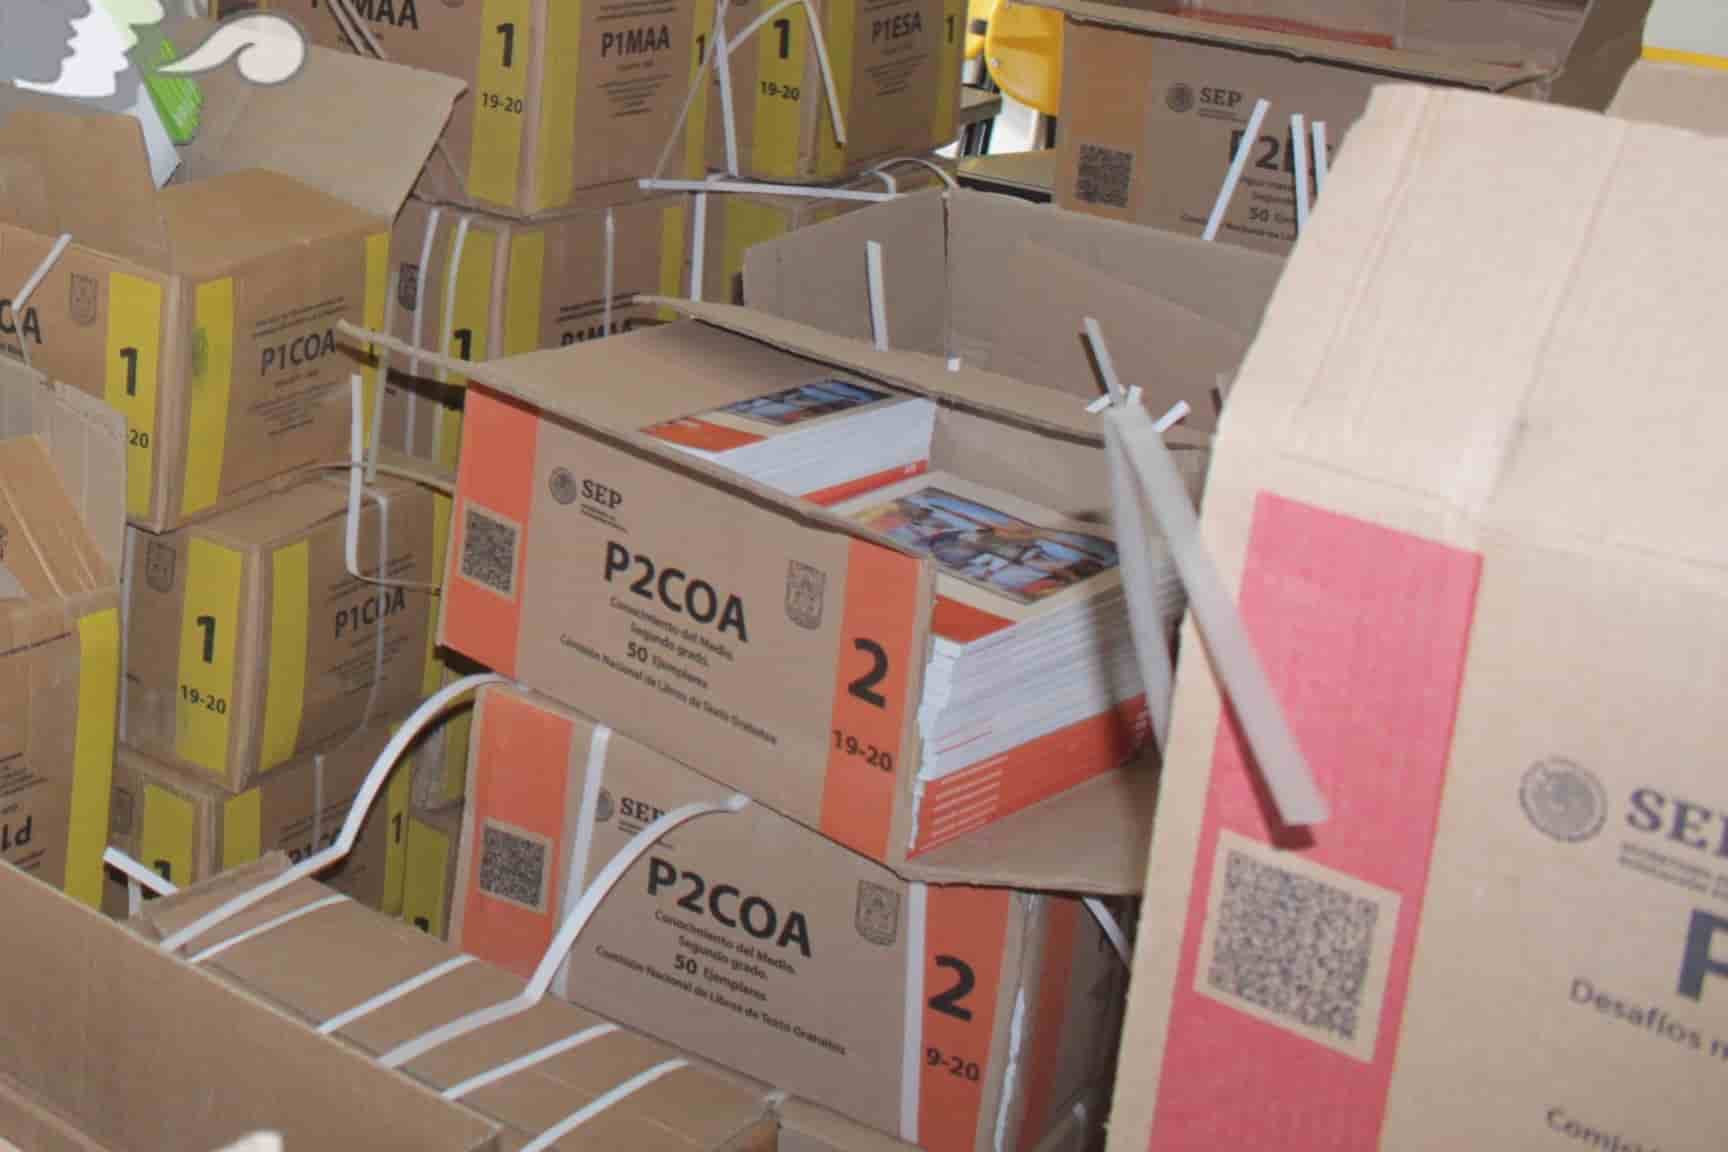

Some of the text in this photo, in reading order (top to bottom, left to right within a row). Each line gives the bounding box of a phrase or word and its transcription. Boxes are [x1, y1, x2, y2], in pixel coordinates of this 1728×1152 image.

[496, 22, 514, 68] 1
[601, 24, 671, 59] P1MAA
[774, 18, 791, 59] 1
[872, 11, 923, 44] P1ESA
[945, 14, 954, 44] 1
[482, 92, 524, 115] 19-20
[761, 80, 800, 101] 19-20
[1200, 86, 1243, 108] SEP
[261, 327, 337, 377] P1COA
[120, 347, 138, 397] 1
[581, 479, 623, 509] SEP
[603, 540, 749, 643] P2COA
[196, 615, 217, 663] 1
[626, 641, 649, 663] 50
[847, 637, 889, 709] 2
[180, 684, 227, 715] 19-20
[832, 729, 894, 772] 19-20
[647, 856, 812, 959] P2COA
[646, 964, 693, 993] Nacional
[674, 953, 698, 975] 50
[927, 954, 977, 1023] 2
[926, 1047, 981, 1082] 9-20
